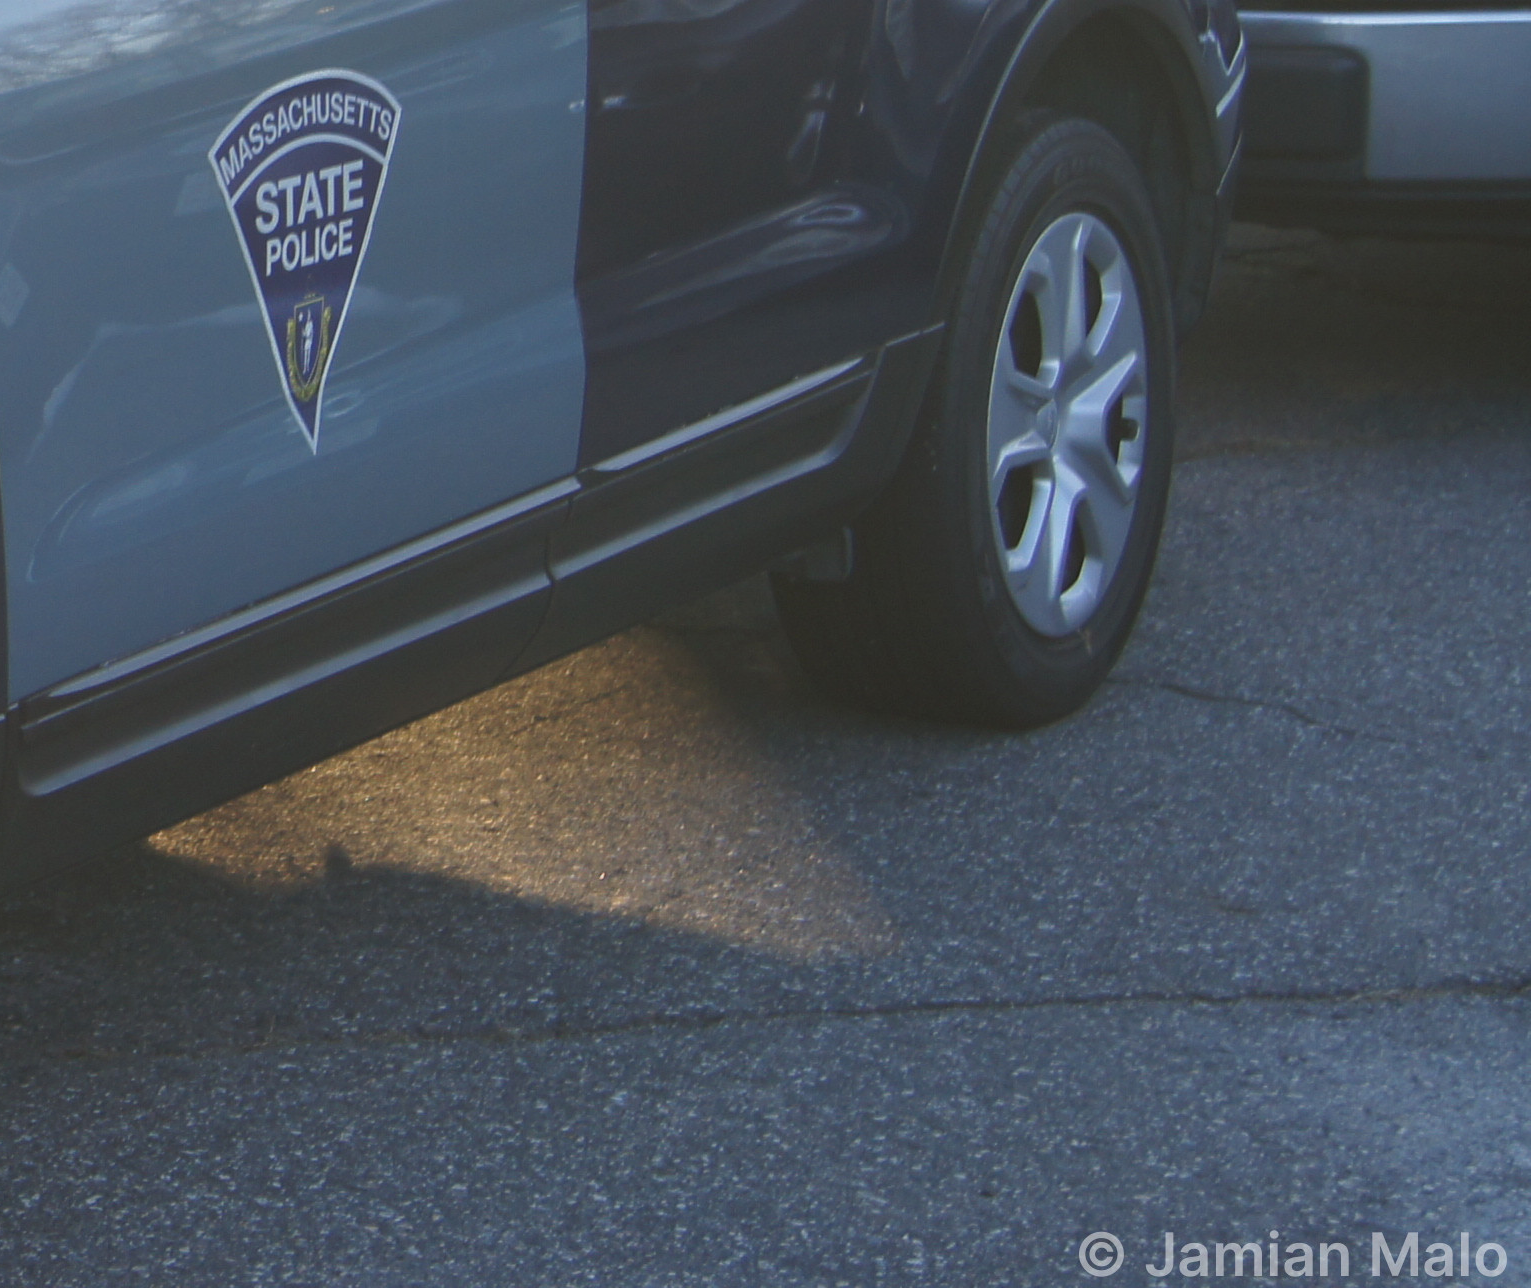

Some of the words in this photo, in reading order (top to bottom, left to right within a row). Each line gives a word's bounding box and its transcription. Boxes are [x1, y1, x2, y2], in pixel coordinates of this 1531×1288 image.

[219, 91, 393, 186] MASSACHUSETTS
[255, 158, 365, 236] STATE
[265, 217, 354, 277] POLICE
